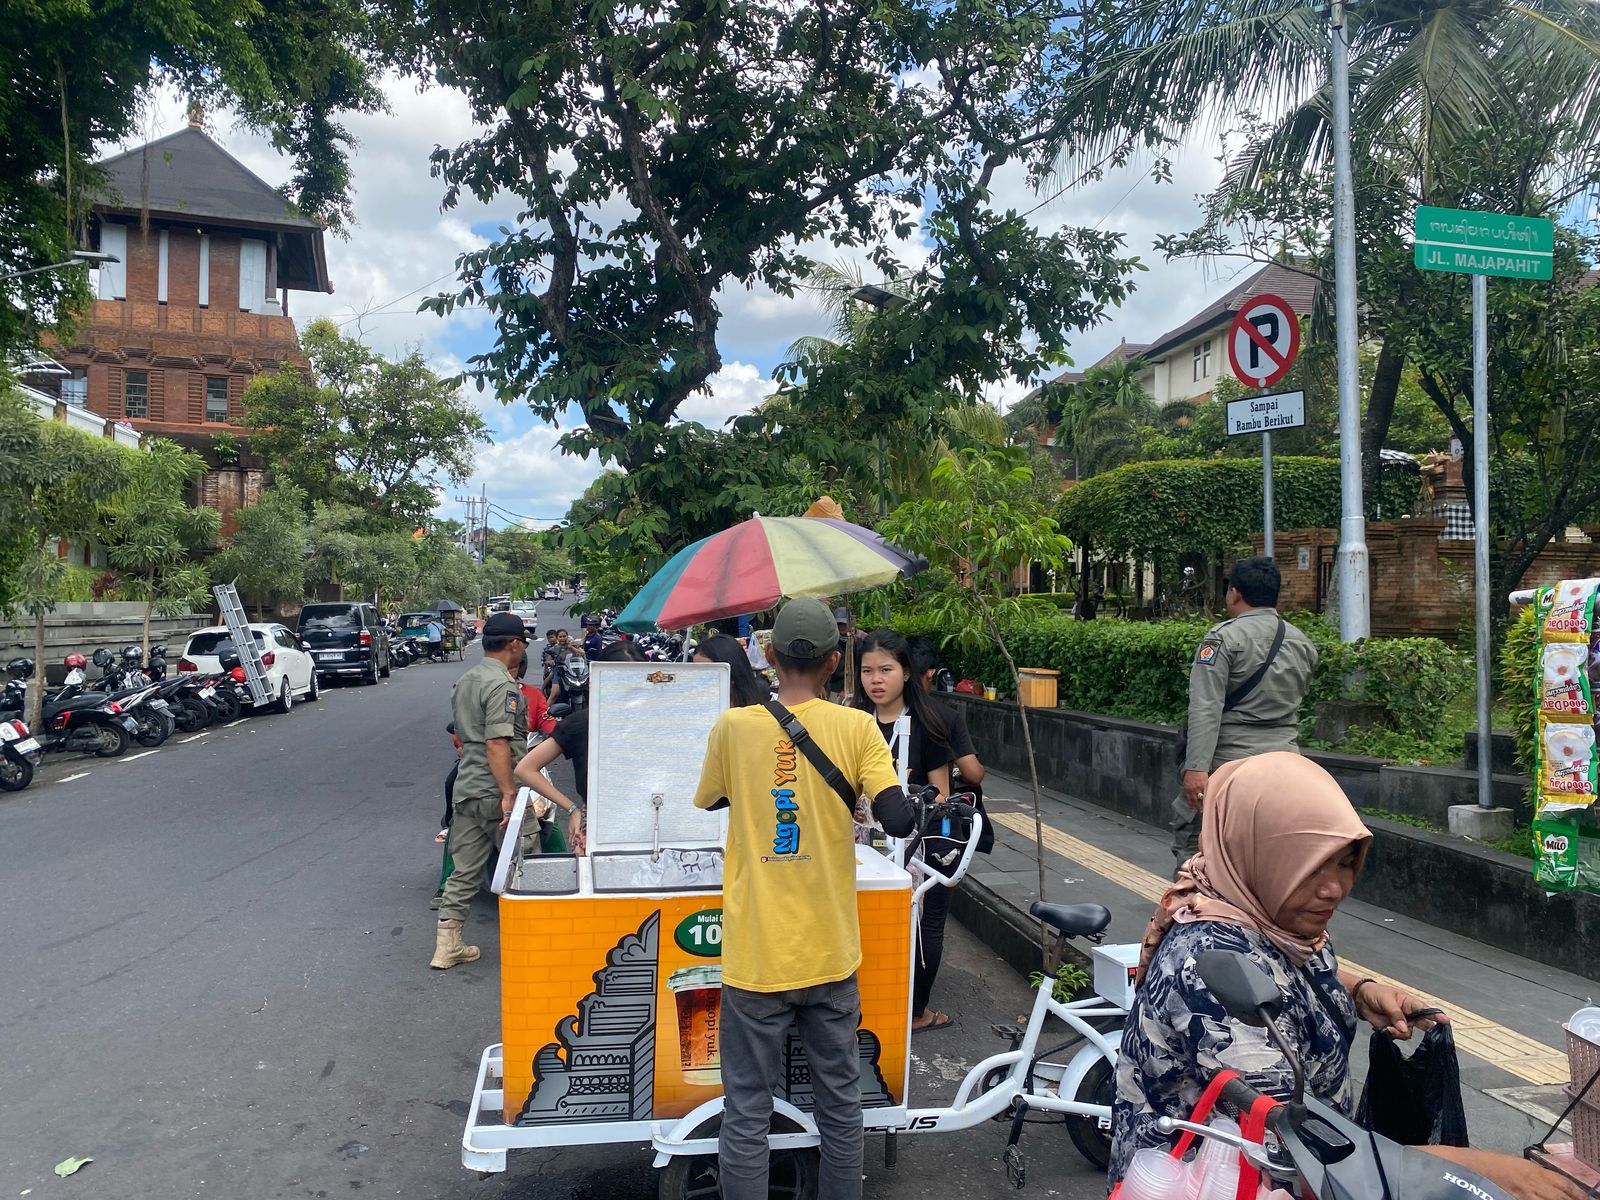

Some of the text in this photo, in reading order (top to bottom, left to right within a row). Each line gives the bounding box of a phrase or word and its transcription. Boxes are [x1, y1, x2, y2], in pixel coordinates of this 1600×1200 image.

[1428, 251, 1541, 274] JL. MAJAPAHIT
[1249, 312, 1279, 369] P
[1250, 398, 1279, 414] Sampai
[1236, 414, 1294, 432] Rambu Berikut
[1563, 619, 1588, 631] Good
[1563, 699, 1589, 711] Good
[774, 740, 797, 787] Yuk
[1549, 777, 1592, 793] Good Day
[771, 789, 800, 855] Ngopi
[1545, 840, 1567, 851] MILO
[697, 914, 719, 923] Mulai
[688, 924, 722, 945] 10
[705, 996, 718, 1031] ngopi
[705, 1033, 718, 1061] yuk.
